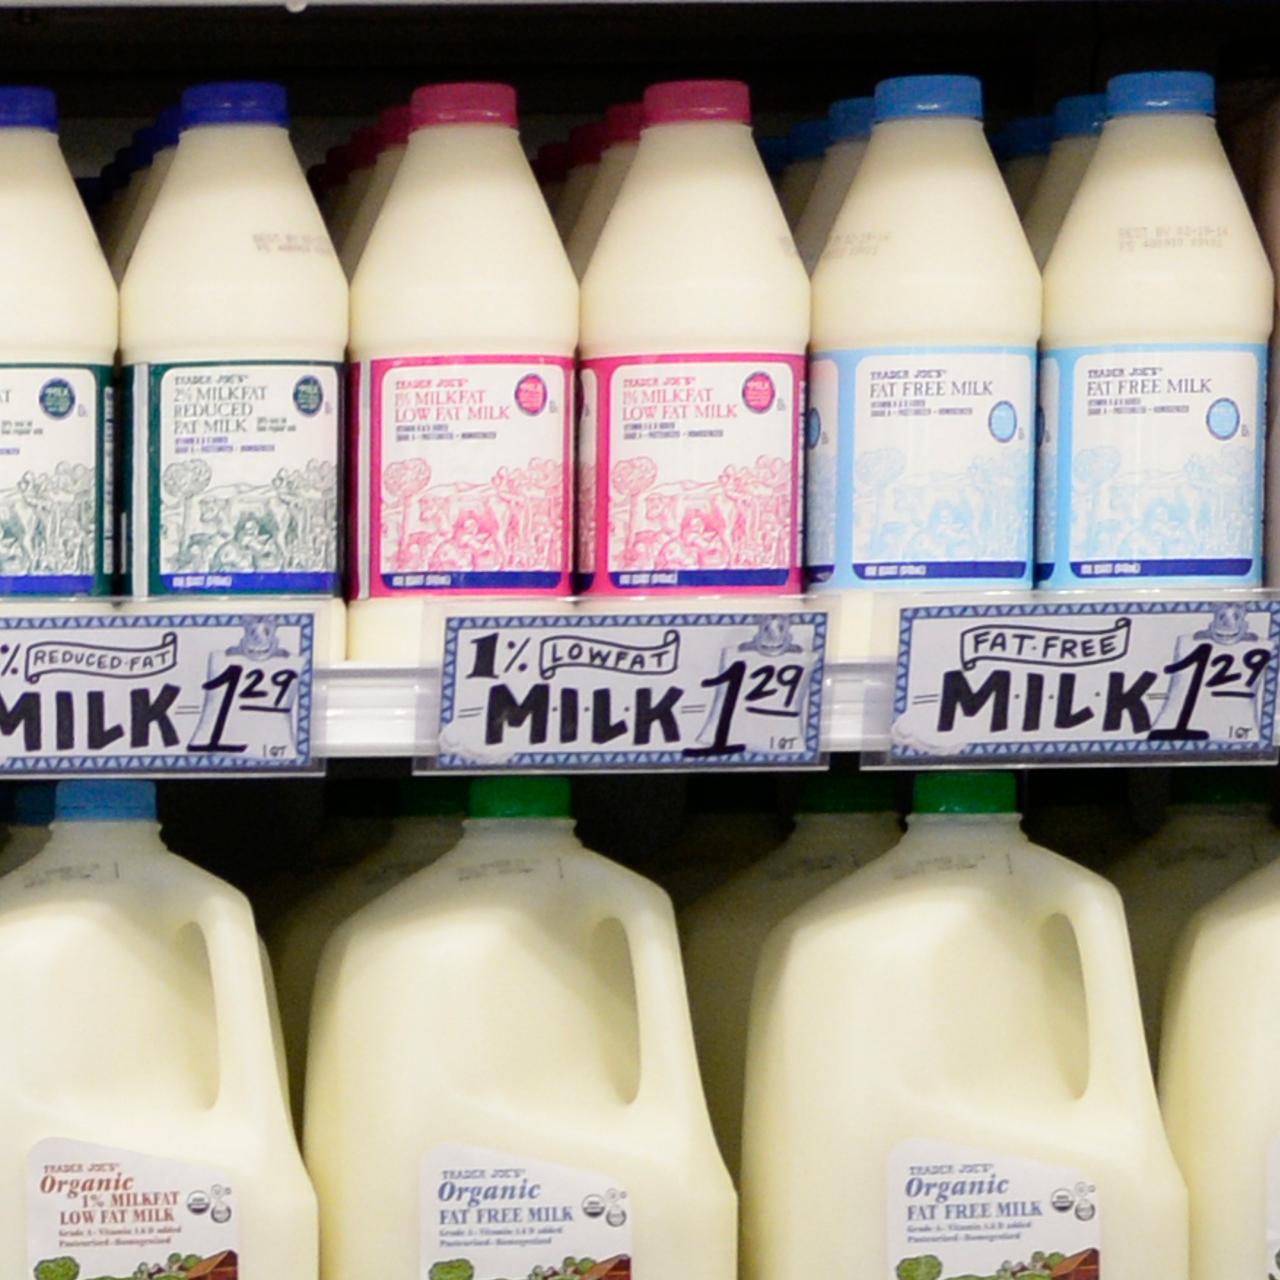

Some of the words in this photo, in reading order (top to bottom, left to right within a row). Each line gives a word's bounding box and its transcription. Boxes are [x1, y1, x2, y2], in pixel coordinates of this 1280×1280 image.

[870, 370, 909, 380] TRADER
[415, 390, 486, 406] MILKFAT
[870, 383, 897, 398] FAT
[902, 381, 946, 397] FREE
[951, 380, 994, 396] MILK
[394, 407, 430, 423] LOW
[435, 407, 461, 422] FAT
[467, 406, 512, 421] MILK
[465, 633, 531, 681] 1%
[551, 643, 670, 669] LOWFAT
[438, 1179, 542, 1206] Organic
[440, 1208, 470, 1225] FAT
[477, 1207, 523, 1224] FREE
[529, 1206, 573, 1222] MILK
